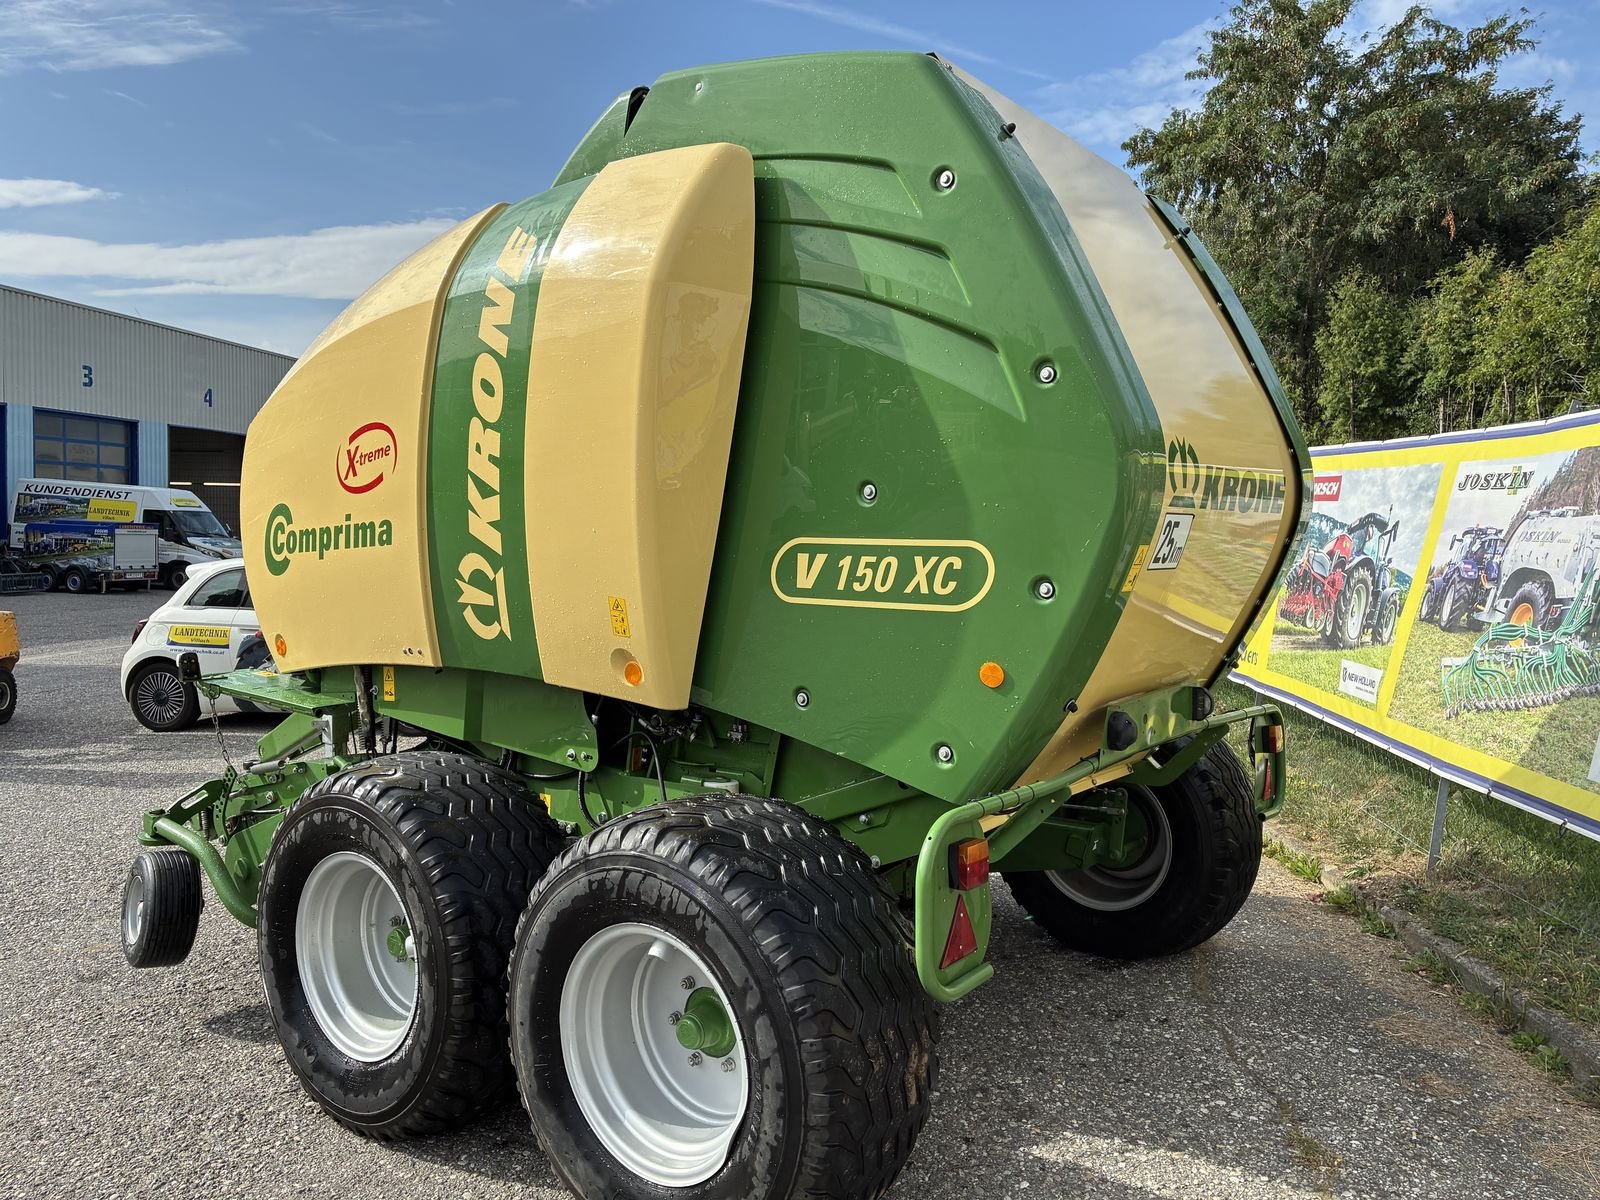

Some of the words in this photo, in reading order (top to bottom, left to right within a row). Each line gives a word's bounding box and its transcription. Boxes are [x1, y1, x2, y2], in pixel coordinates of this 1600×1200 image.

[82, 365, 93, 387] 3
[203, 388, 213, 407] 4
[467, 226, 537, 556] KRONE
[343, 444, 391, 480] X-treme
[1200, 465, 1286, 513] KRONE
[1458, 470, 1535, 491] JOSKIN
[24, 483, 132, 500] KUNDENDIENST
[89, 507, 130, 517] LANDTECHNIK
[265, 503, 393, 576] Comprima
[796, 553, 828, 589] V
[837, 555, 898, 593] 150
[903, 556, 962, 595] XC
[174, 627, 228, 638] LANDTECHNIK
[1348, 672, 1358, 683] NEW
